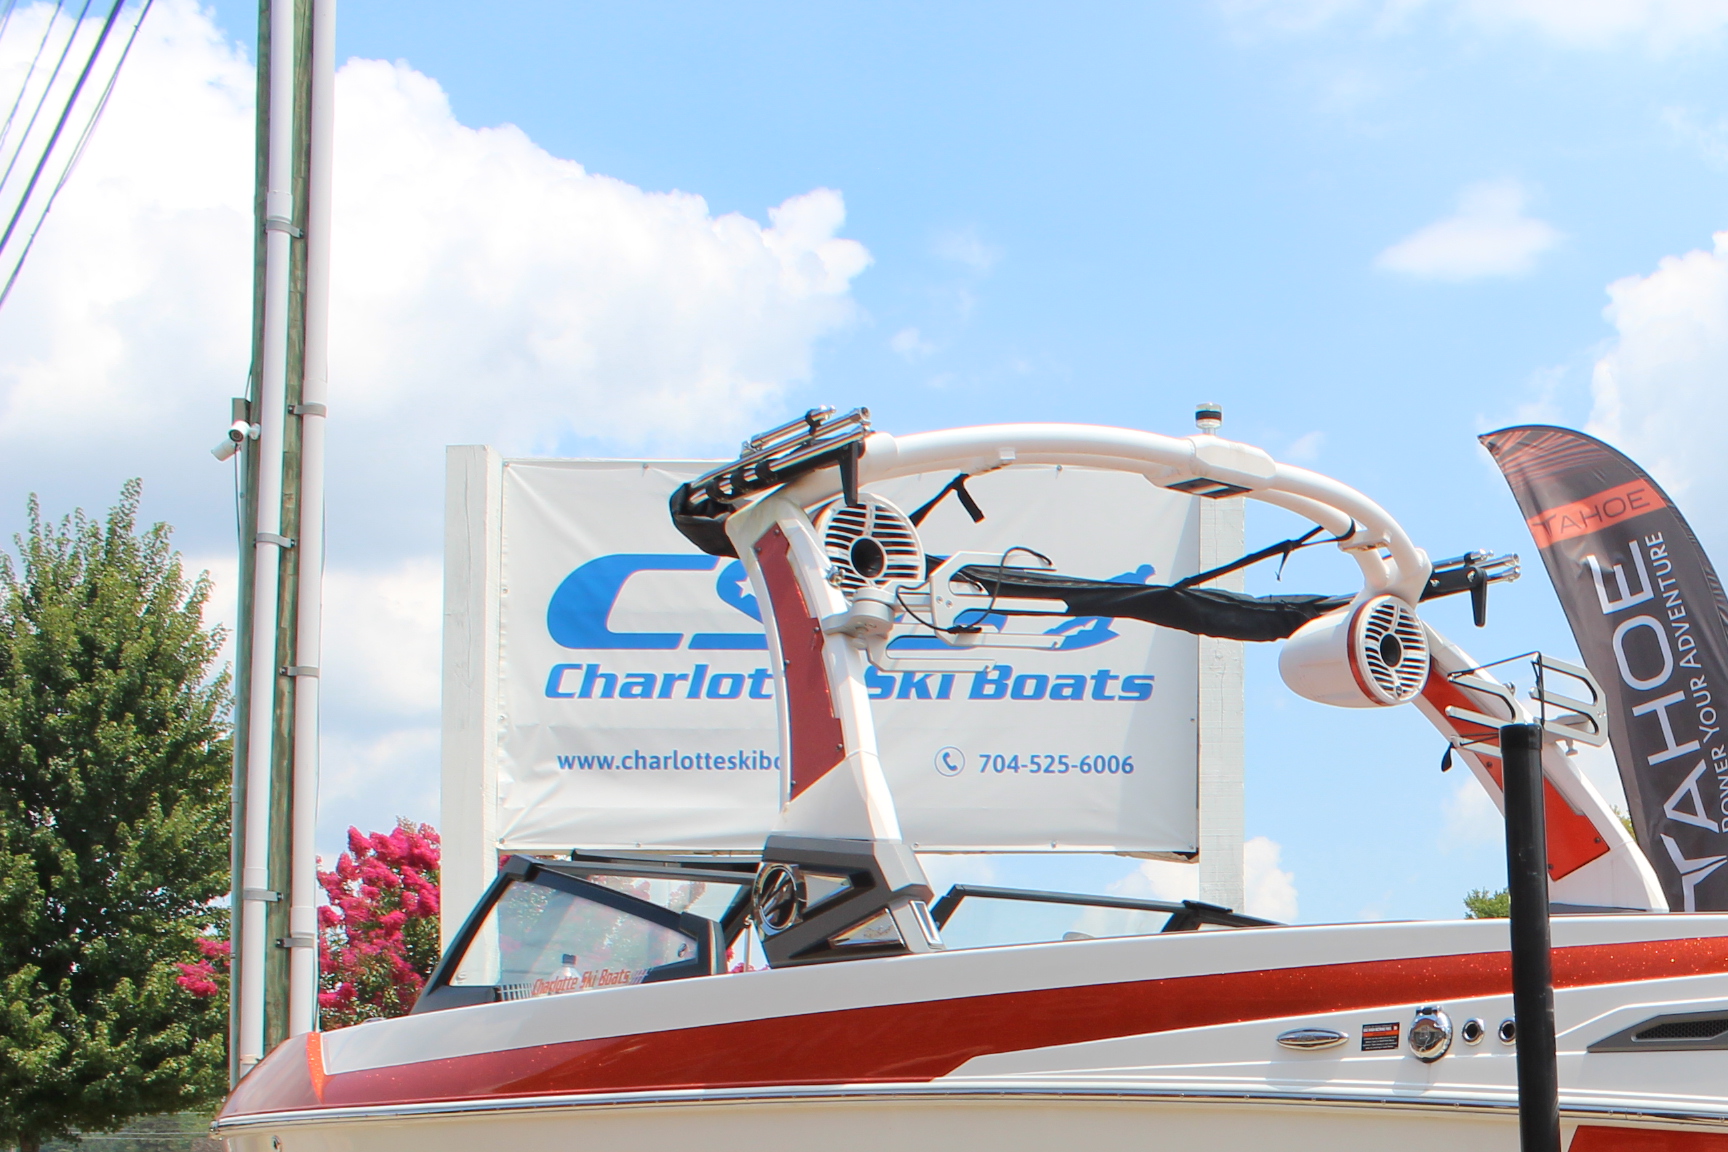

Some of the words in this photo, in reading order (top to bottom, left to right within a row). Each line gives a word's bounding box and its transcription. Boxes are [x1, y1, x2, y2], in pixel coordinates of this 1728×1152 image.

[1531, 488, 1651, 538] TAHOE
[1644, 531, 1702, 669] ADVENTURE
[545, 663, 774, 700] Charlot
[864, 664, 956, 700] Ski
[967, 664, 1156, 702] Boats
[1689, 674, 1720, 743] YOUR
[557, 749, 781, 771] www.charlotteskib
[978, 753, 1135, 774] 704-525-6006
[532, 975, 579, 996] Charlotte
[580, 970, 598, 989] Ski
[598, 968, 631, 986] Boats
